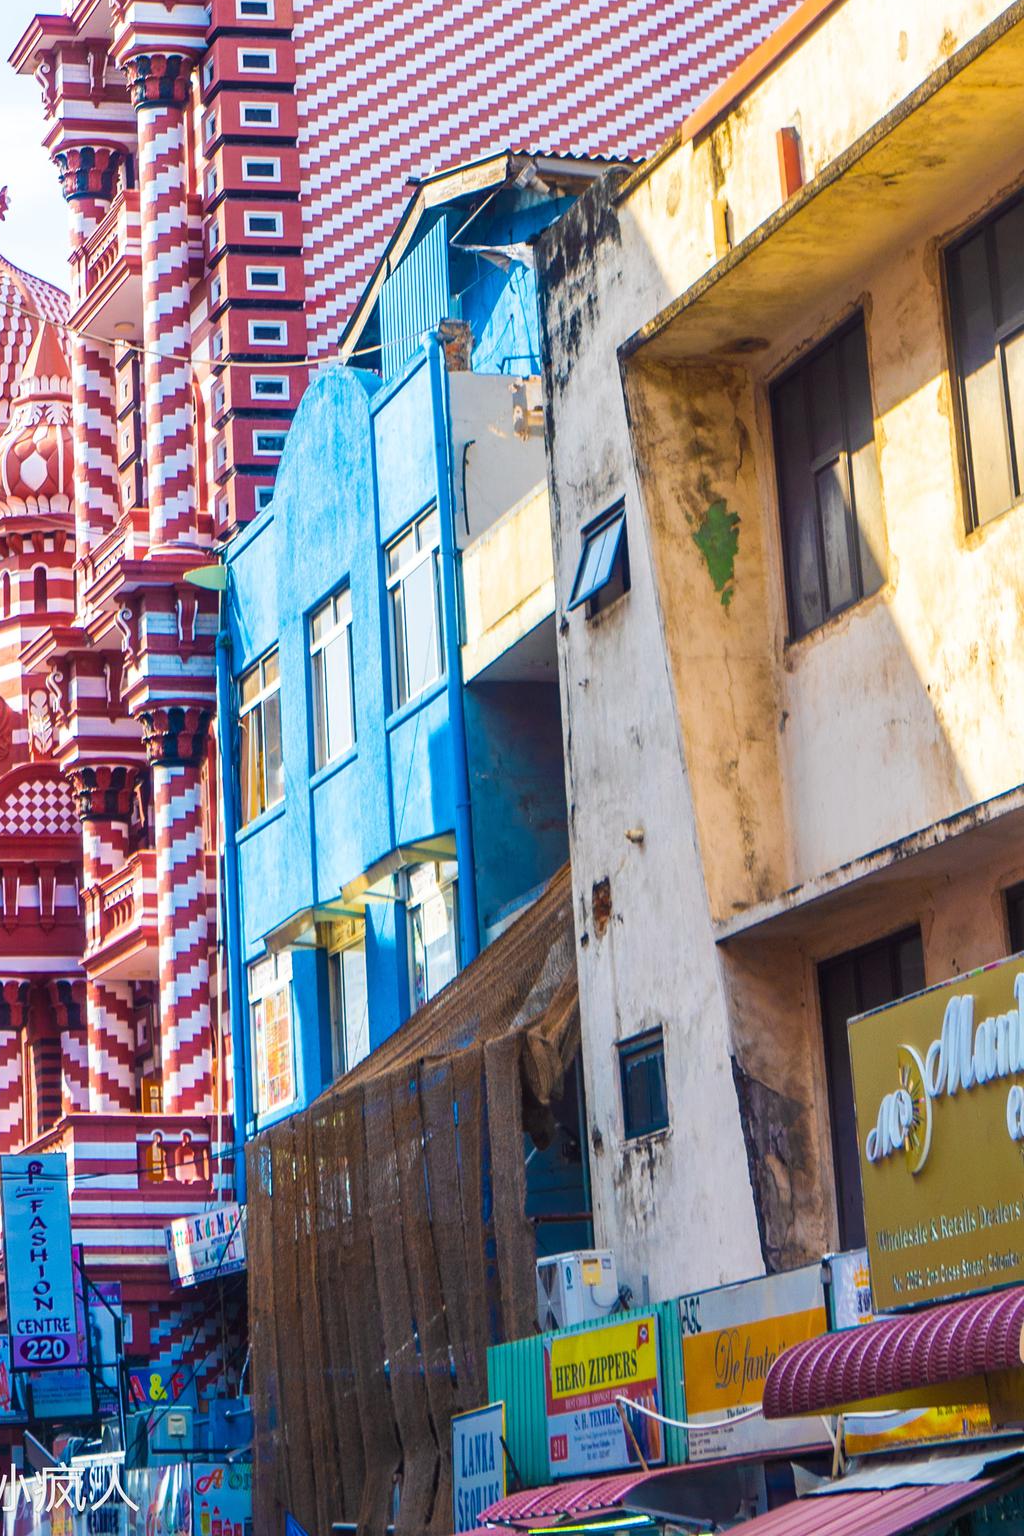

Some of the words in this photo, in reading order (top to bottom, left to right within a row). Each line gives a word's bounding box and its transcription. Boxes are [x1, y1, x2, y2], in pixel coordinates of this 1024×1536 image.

[876, 1222, 928, 1252] Wholesale
[930, 1217, 939, 1242] &
[940, 1208, 977, 1239] Retails
[29, 1199, 55, 1312] FASHION
[17, 1317, 72, 1335] CENTRE
[26, 1339, 66, 1360] 220
[555, 1362, 586, 1394] HERO
[588, 1348, 638, 1386] ZIPPERS
[129, 1375, 147, 1402] A
[149, 1373, 168, 1401] &
[460, 1431, 496, 1478] LANKA
